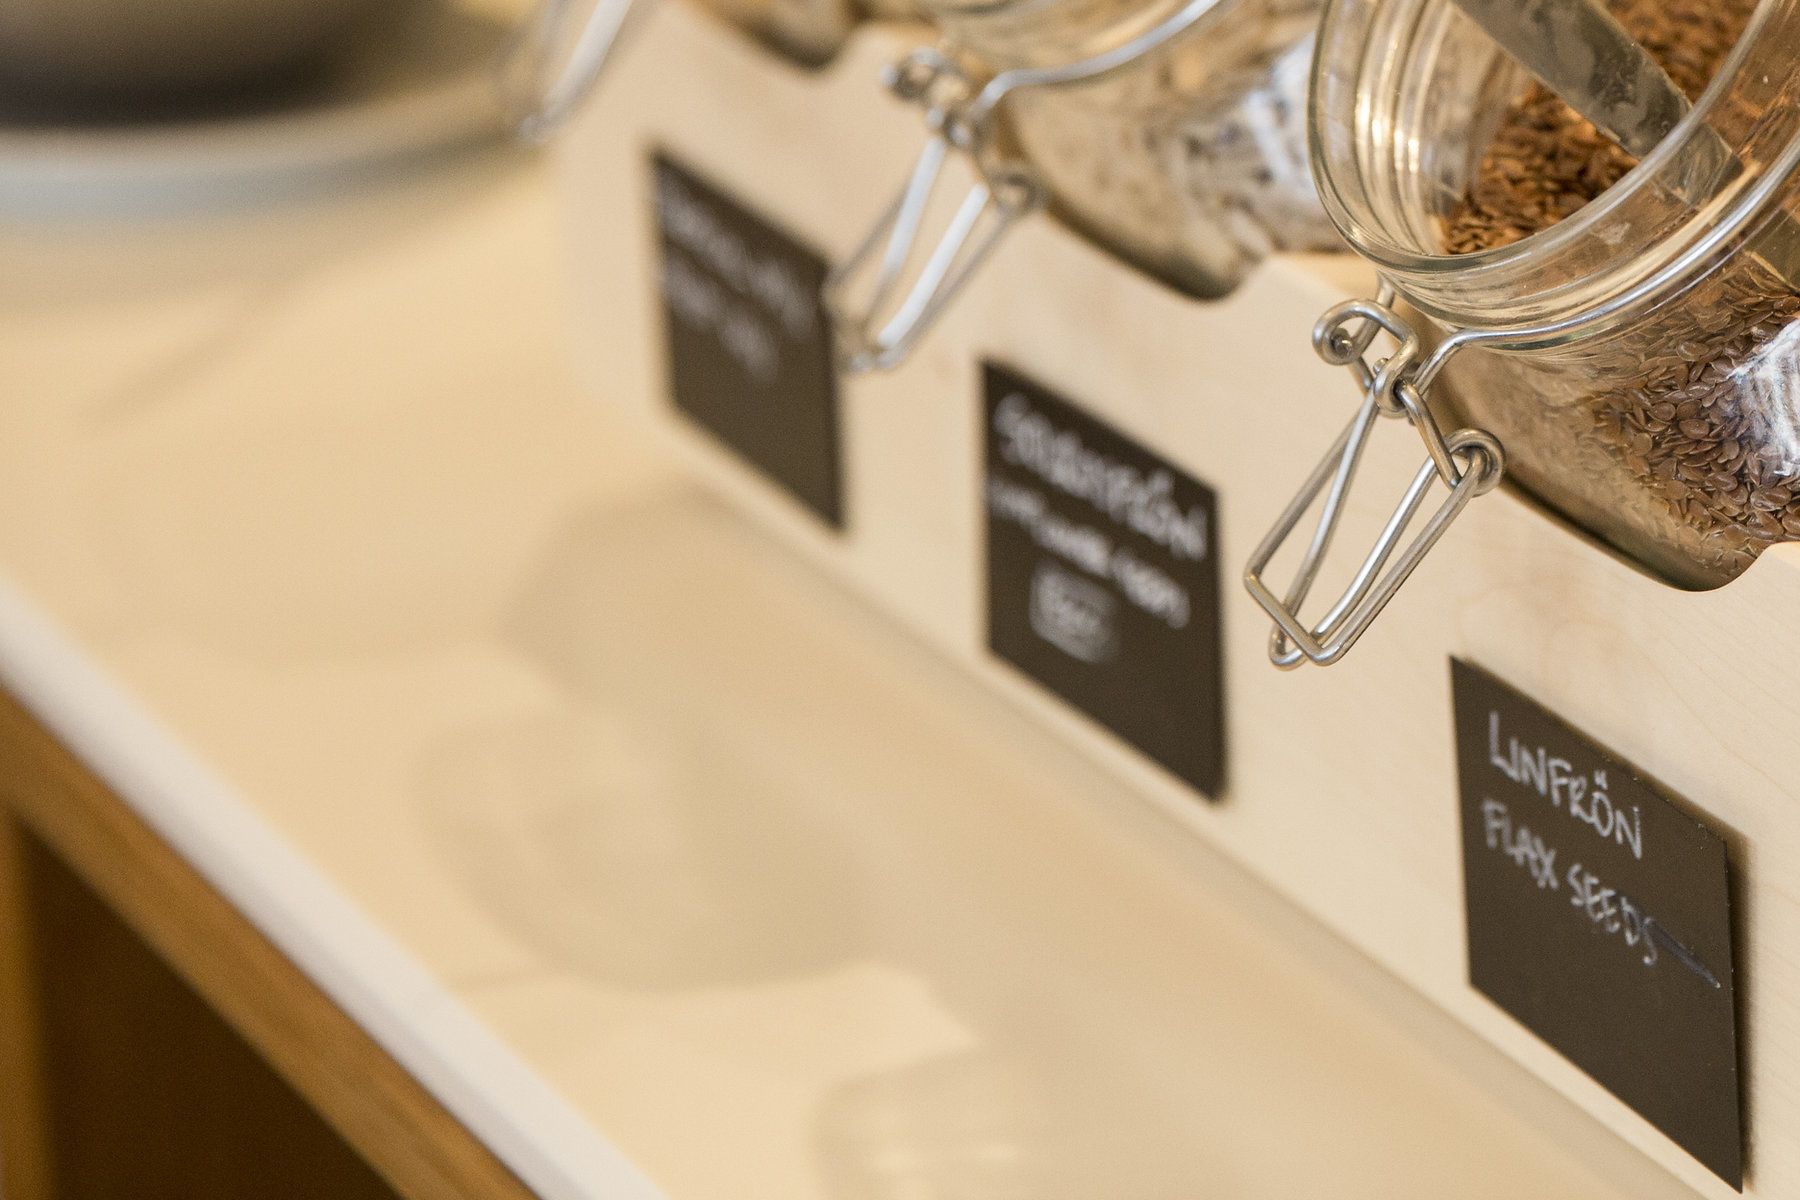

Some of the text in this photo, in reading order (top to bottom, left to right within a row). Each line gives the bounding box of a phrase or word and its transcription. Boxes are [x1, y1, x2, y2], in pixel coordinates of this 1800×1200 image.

[1488, 710, 1643, 860] LINFRÖN
[1481, 798, 1657, 966] FLAX SEEDS
